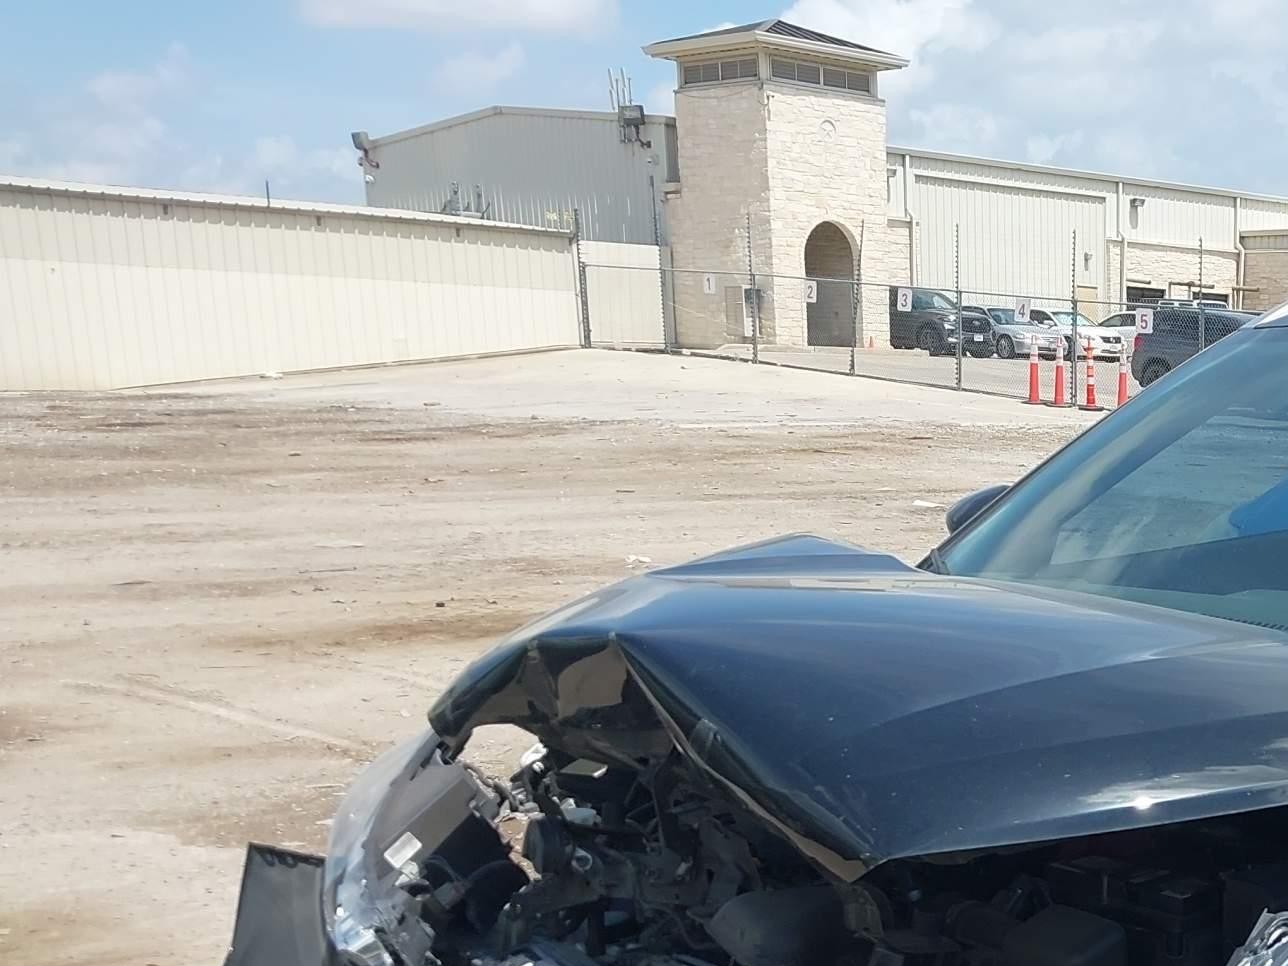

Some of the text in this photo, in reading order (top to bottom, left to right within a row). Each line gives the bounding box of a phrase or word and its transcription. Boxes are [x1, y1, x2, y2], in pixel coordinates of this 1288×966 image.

[806, 285, 814, 299] 2
[901, 291, 908, 307] 3
[1018, 304, 1026, 318] 4
[1140, 313, 1149, 330] 5
